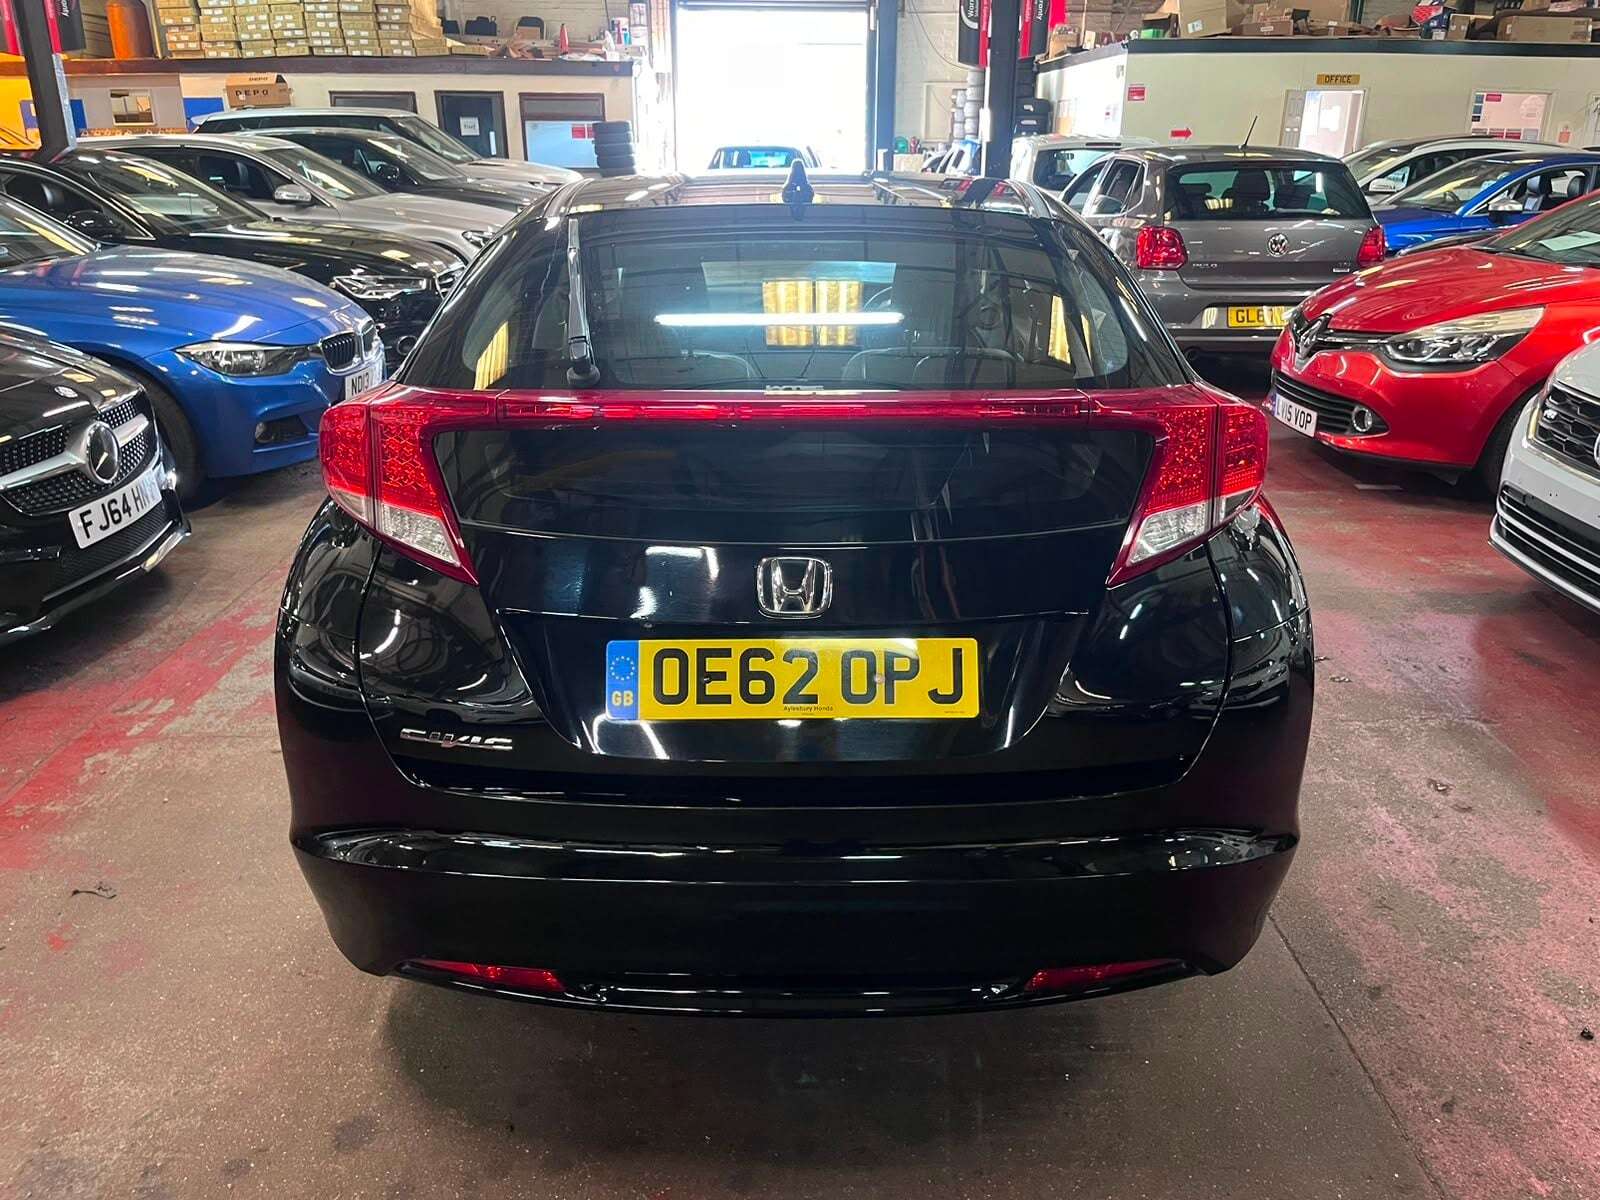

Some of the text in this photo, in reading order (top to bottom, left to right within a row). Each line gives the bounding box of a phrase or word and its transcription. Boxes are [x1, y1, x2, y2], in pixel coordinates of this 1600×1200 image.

[1324, 74, 1352, 84] OFFICE
[79, 493, 132, 539] FJ64
[652, 647, 964, 706] OE62 OPJ
[612, 690, 634, 707] GB
